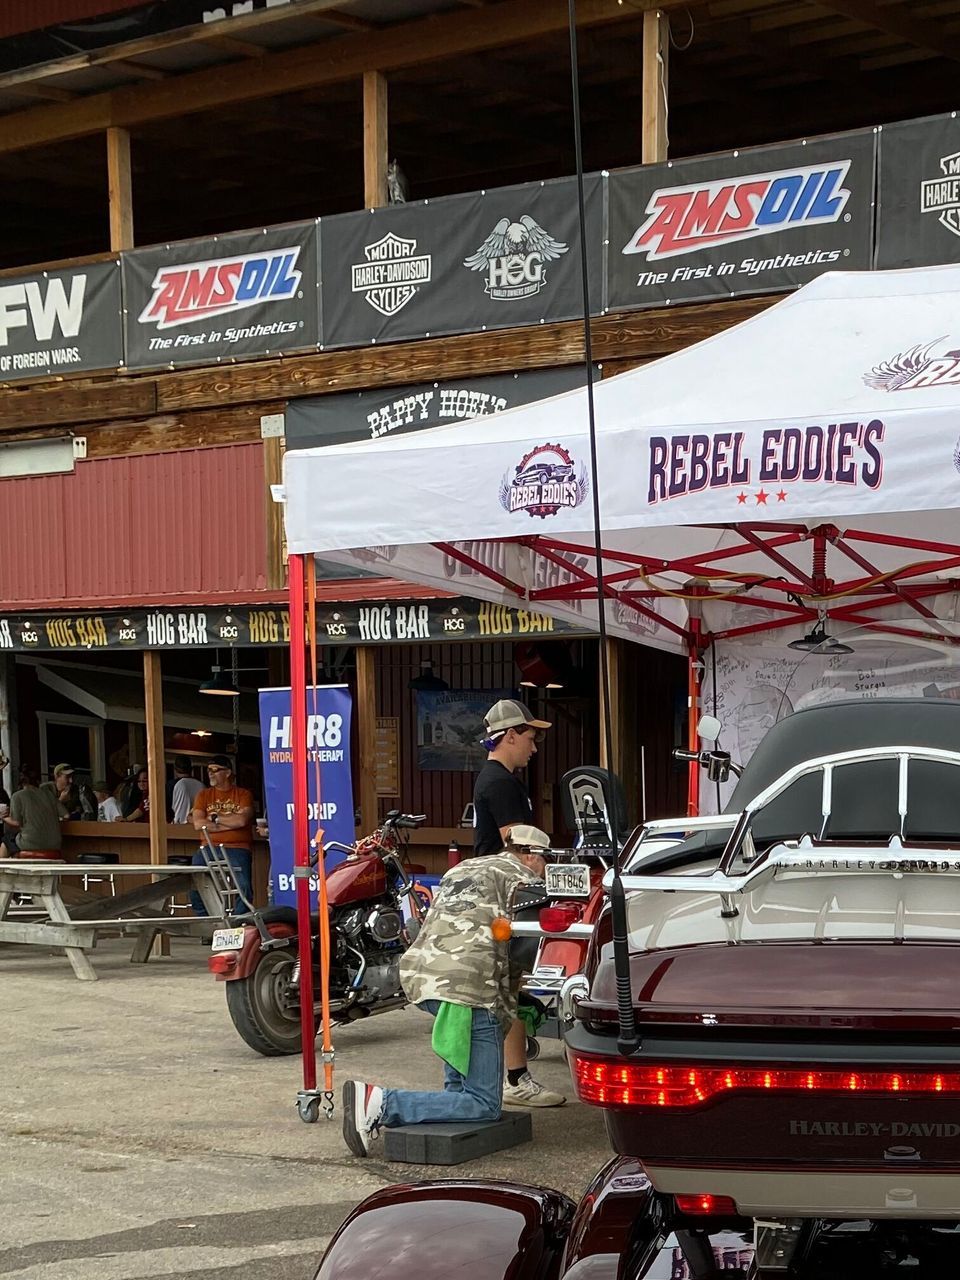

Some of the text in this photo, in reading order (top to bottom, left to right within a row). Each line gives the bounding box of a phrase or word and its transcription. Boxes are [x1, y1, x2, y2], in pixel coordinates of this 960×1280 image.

[635, 168, 844, 254] AMSOIL
[371, 239, 410, 260] MOTOR
[355, 260, 428, 286] HARLEY-DAVIDSON
[637, 249, 842, 287] The First in Synthetics
[147, 253, 297, 325] AMSOIL
[371, 286, 412, 312] CYCLES
[149, 321, 298, 351] The First in Synthetics
[0, 358, 12, 371] OF
[13, 350, 50, 369] FOREIGN
[367, 391, 434, 439] PAPPY
[648, 418, 886, 505] REBEL EDDIE'S
[510, 485, 540, 511] REBEL
[46, 616, 108, 647] HOG BAR
[147, 612, 208, 645] HOG BAR
[249, 610, 279, 643] HOG
[358, 605, 430, 641] HOG BAR
[478, 603, 513, 636] HOG
[269, 713, 343, 749] HR8
